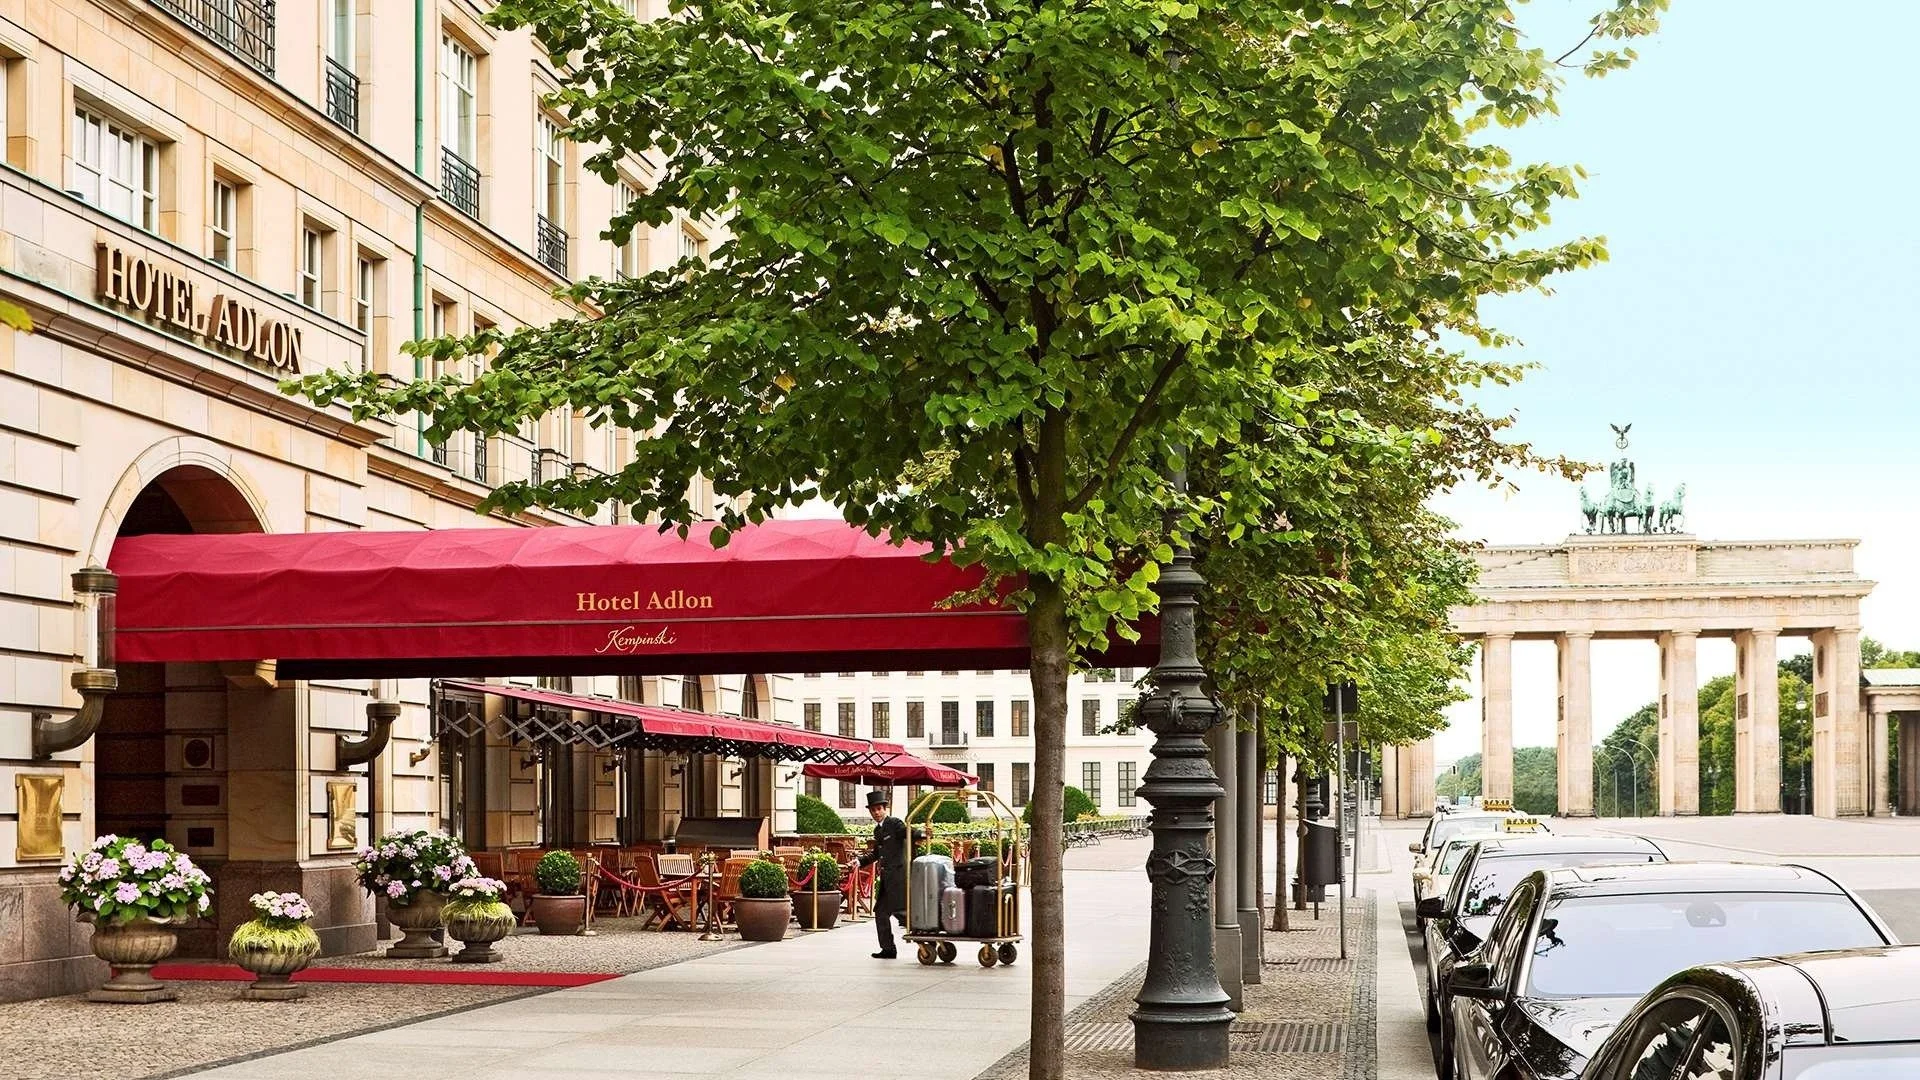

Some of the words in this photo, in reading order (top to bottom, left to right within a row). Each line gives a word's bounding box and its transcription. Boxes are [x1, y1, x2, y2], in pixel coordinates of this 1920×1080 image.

[97, 242, 210, 337] HOTEL
[213, 294, 302, 374] ADLON
[576, 591, 640, 611] Hotel
[646, 590, 713, 610] Adlon
[595, 625, 678, 653] Kempinski
